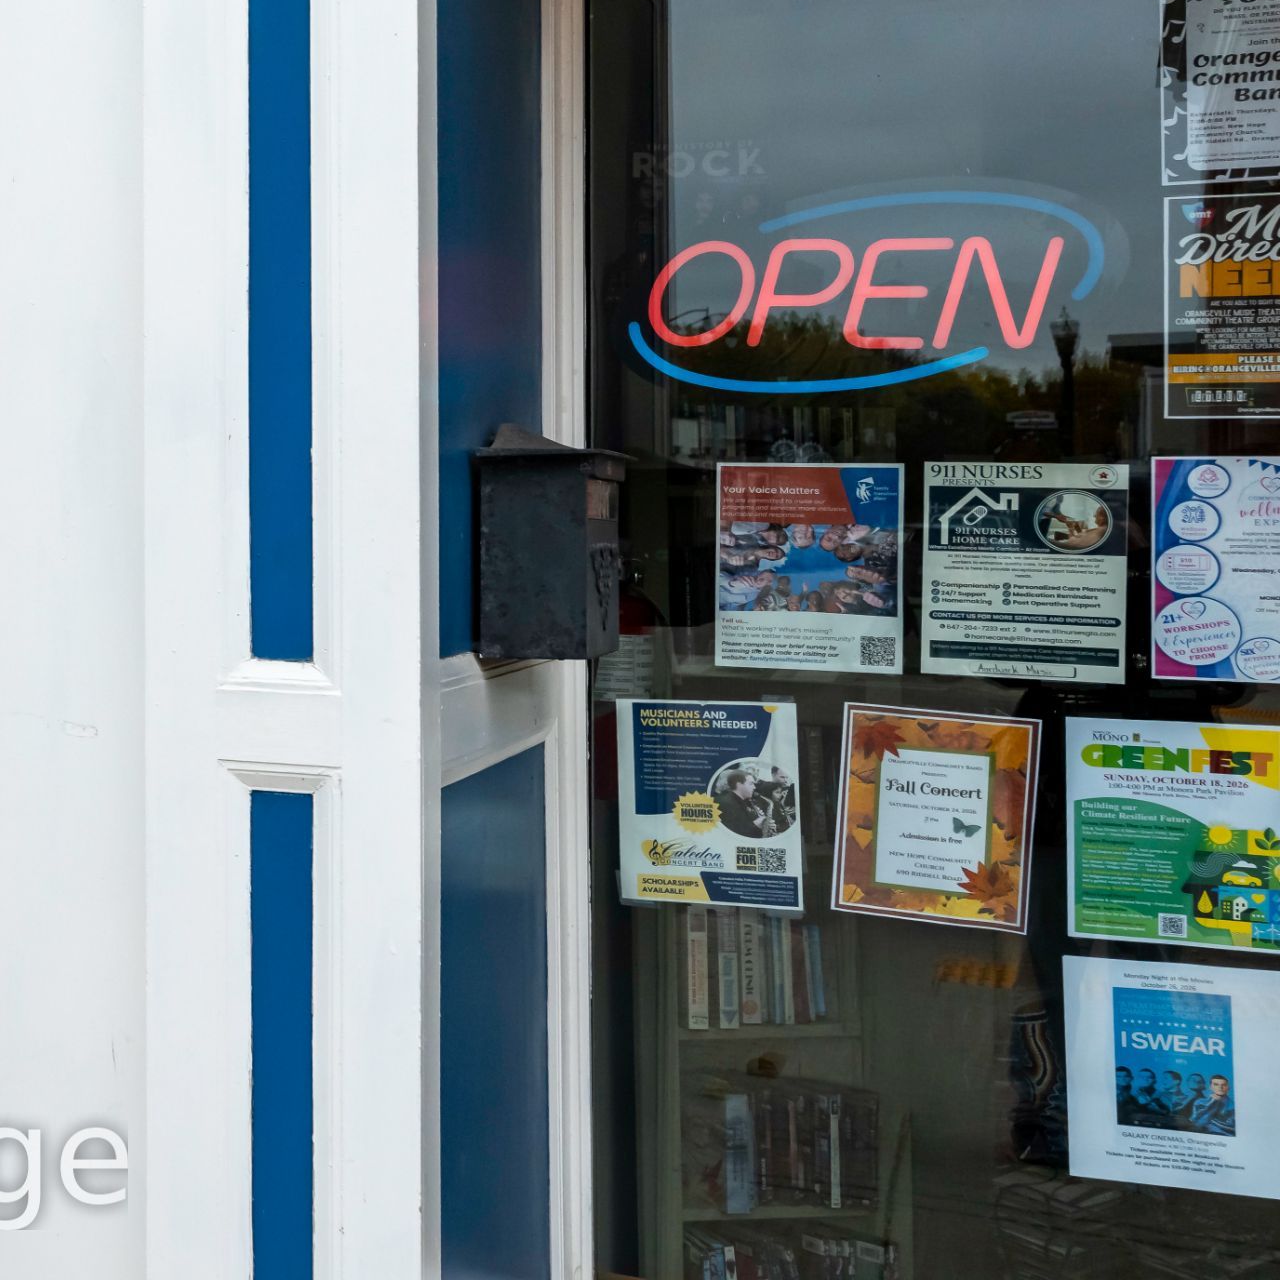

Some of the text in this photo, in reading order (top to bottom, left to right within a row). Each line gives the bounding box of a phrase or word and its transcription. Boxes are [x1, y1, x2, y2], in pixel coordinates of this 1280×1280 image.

[632, 148, 767, 178] ROCK
[648, 236, 1063, 349] OPEN
[930, 464, 1043, 479] 911 NURSES
[723, 486, 820, 495] Your Voice Matters
[973, 528, 1018, 536] NURSES
[952, 536, 1020, 545] HOME CARE
[941, 582, 1001, 590] Companionship
[1013, 584, 1060, 592] Personalized
[1082, 586, 1116, 594] Planning
[1013, 591, 1055, 599] Medication
[941, 597, 993, 606] Homemaking
[1031, 600, 1068, 608] Operative
[1066, 617, 1116, 625] INFORMATION
[1164, 620, 1230, 634] WORKSHOPS
[1190, 644, 1229, 654] CHOOSE
[640, 709, 727, 719] MUSICIANS AND
[641, 718, 757, 730] VOLUNTEERS NEEDED!
[1092, 732, 1129, 742] MONO
[1152, 777, 1249, 789] OCTOBER 2026
[885, 778, 982, 799] Fall Concert
[1081, 801, 1119, 811] Building
[681, 808, 713, 818] HOURS
[1081, 810, 1191, 824] Climate Resilient Future
[701, 860, 724, 868] BAND
[736, 854, 756, 865] FOR
[642, 878, 699, 887] SCHOLARSHIPS
[642, 887, 685, 895] AVAILABLE!
[1121, 1031, 1226, 1057] I SWEAR
